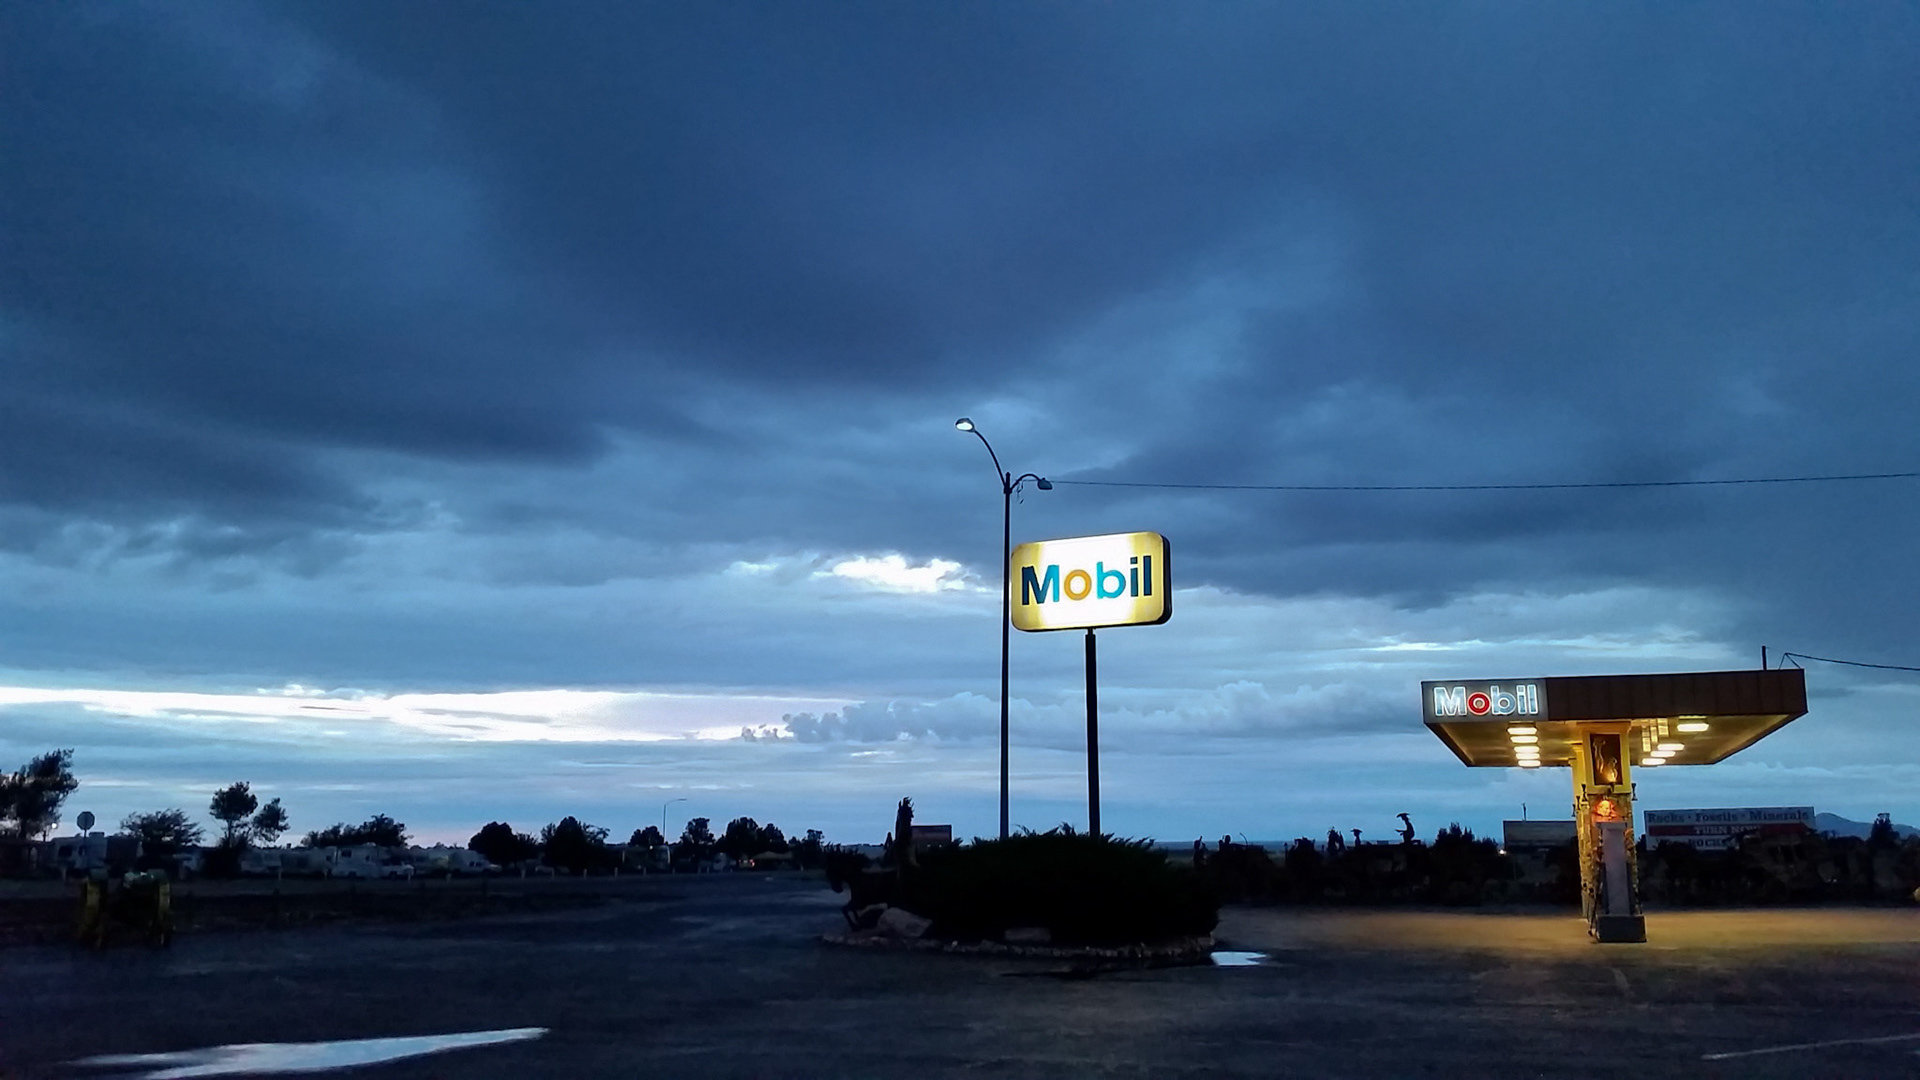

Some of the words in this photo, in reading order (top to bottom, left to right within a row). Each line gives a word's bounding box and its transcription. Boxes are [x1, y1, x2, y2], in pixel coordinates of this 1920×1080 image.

[1021, 555, 1152, 605] Mobil
[1433, 684, 1539, 716] Mobil
[1695, 811, 1738, 822] Fossils
[1749, 810, 1809, 822] Minerals
[1694, 825, 1728, 834] TURN
